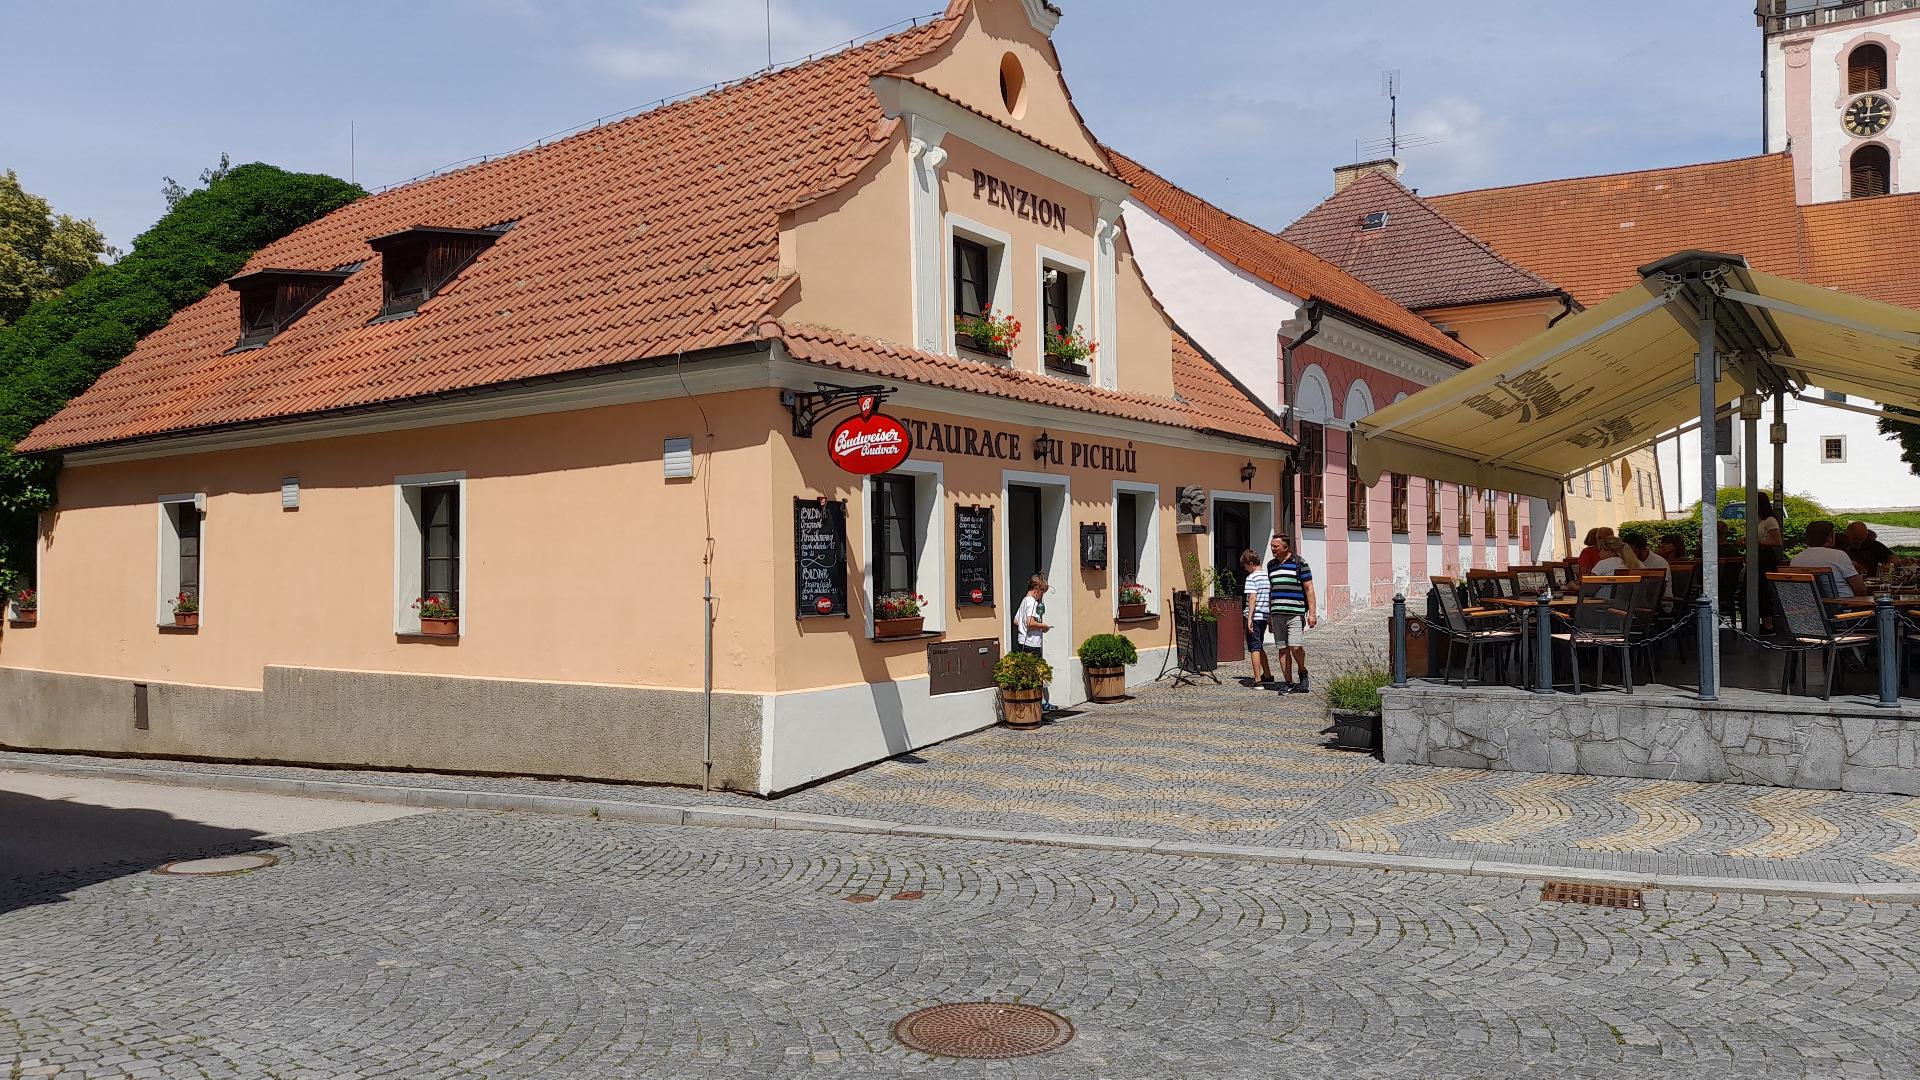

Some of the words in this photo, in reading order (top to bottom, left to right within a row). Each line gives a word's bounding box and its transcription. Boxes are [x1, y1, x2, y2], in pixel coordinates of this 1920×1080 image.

[972, 168, 1067, 233] PENZION
[834, 428, 901, 454] Budweiser
[861, 443, 900, 456] Budvar
[900, 418, 1021, 461] TAURACE
[1048, 438, 1064, 465] U
[1071, 441, 1137, 473] PICHLŮ
